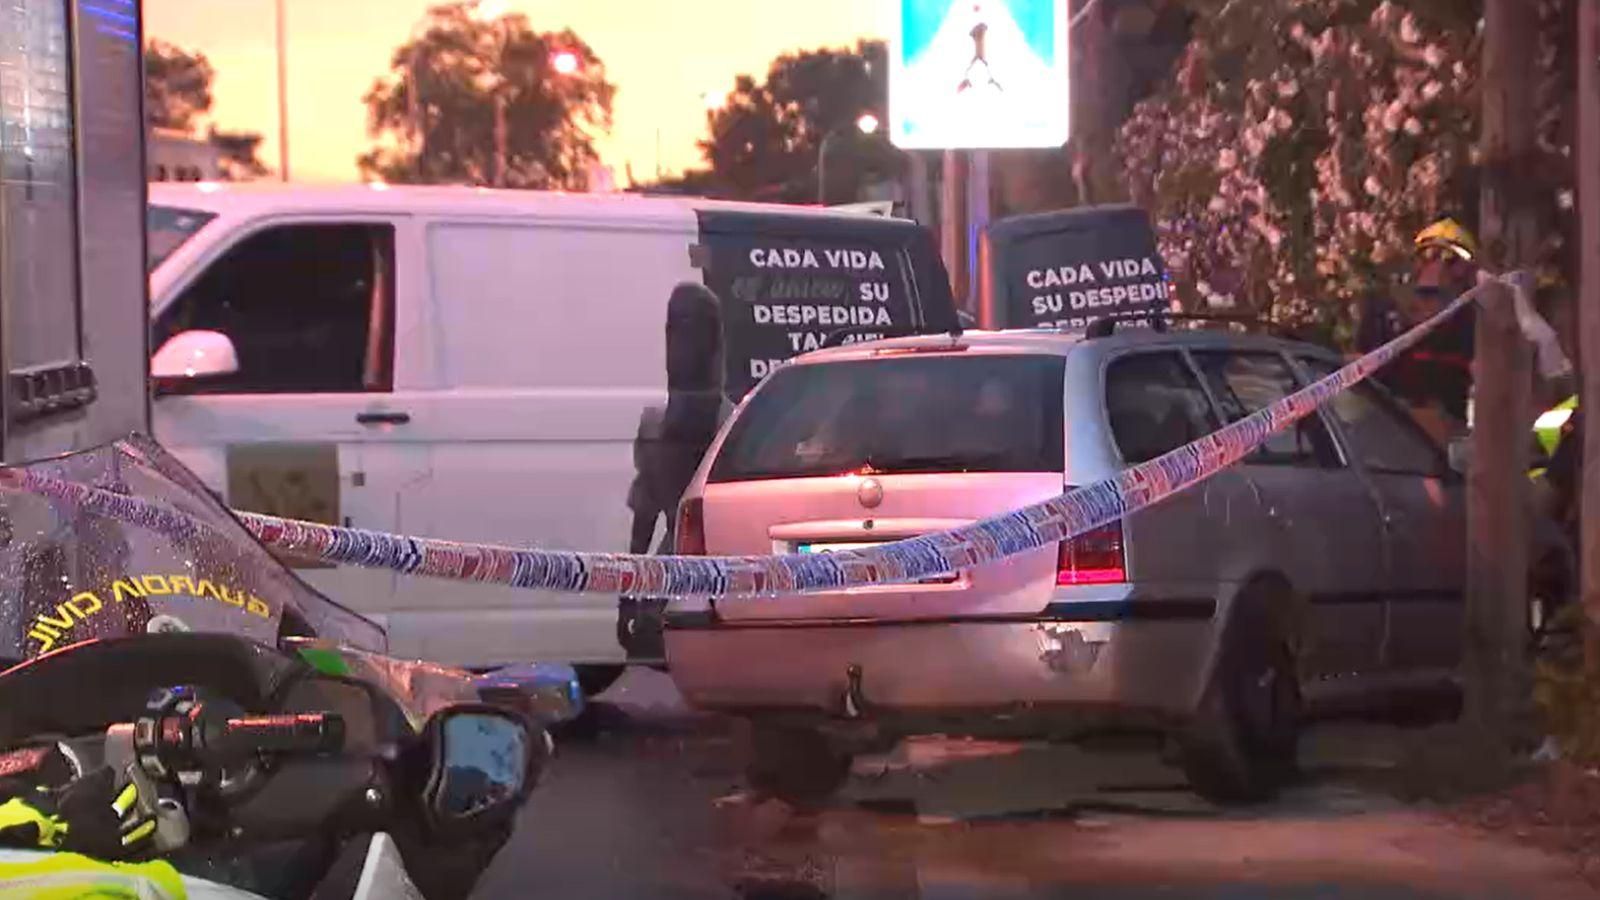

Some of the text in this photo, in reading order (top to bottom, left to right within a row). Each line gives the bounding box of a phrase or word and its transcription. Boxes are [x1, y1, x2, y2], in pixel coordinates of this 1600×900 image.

[749, 248, 885, 270] CADA VIDA
[1026, 257, 1157, 289] CADA VIDA
[859, 282, 890, 302] SU
[753, 304, 892, 326] DESPEDIDA
[1031, 293, 1064, 316] SU
